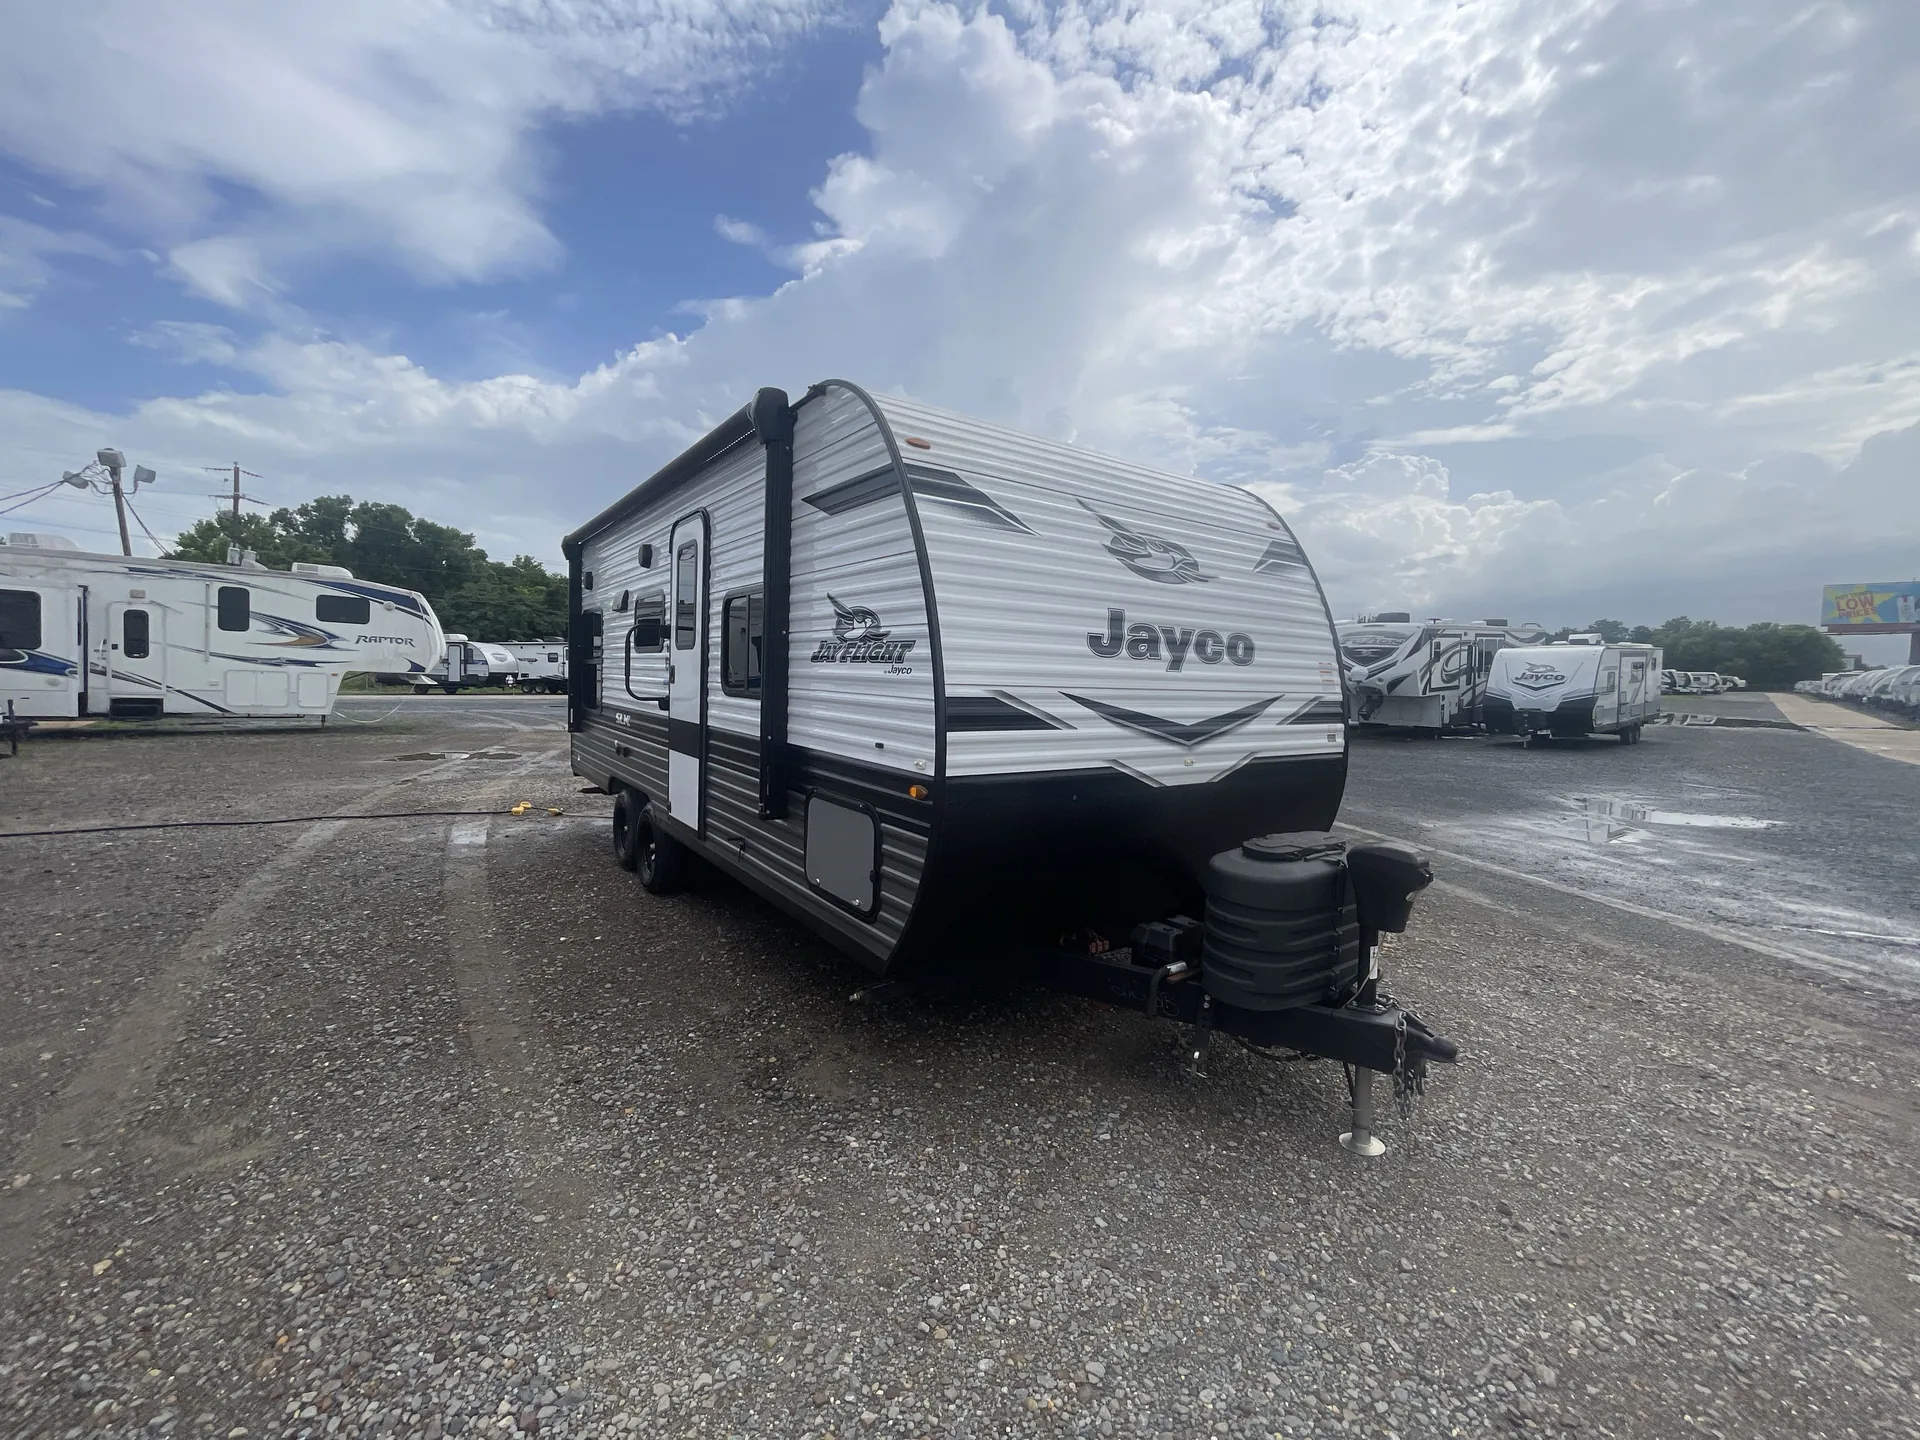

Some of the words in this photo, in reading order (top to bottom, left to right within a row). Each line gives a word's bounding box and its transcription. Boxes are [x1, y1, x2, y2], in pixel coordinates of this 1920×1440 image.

[1837, 594, 1874, 611] LOW
[1838, 606, 1877, 618] PRICES
[355, 635, 416, 648] RAPTOR
[1086, 608, 1256, 672] Jayco
[811, 640, 846, 663] JAY
[840, 640, 916, 664] FLIGHT
[888, 665, 912, 675] Jayco
[1514, 672, 1566, 683] Jayco
